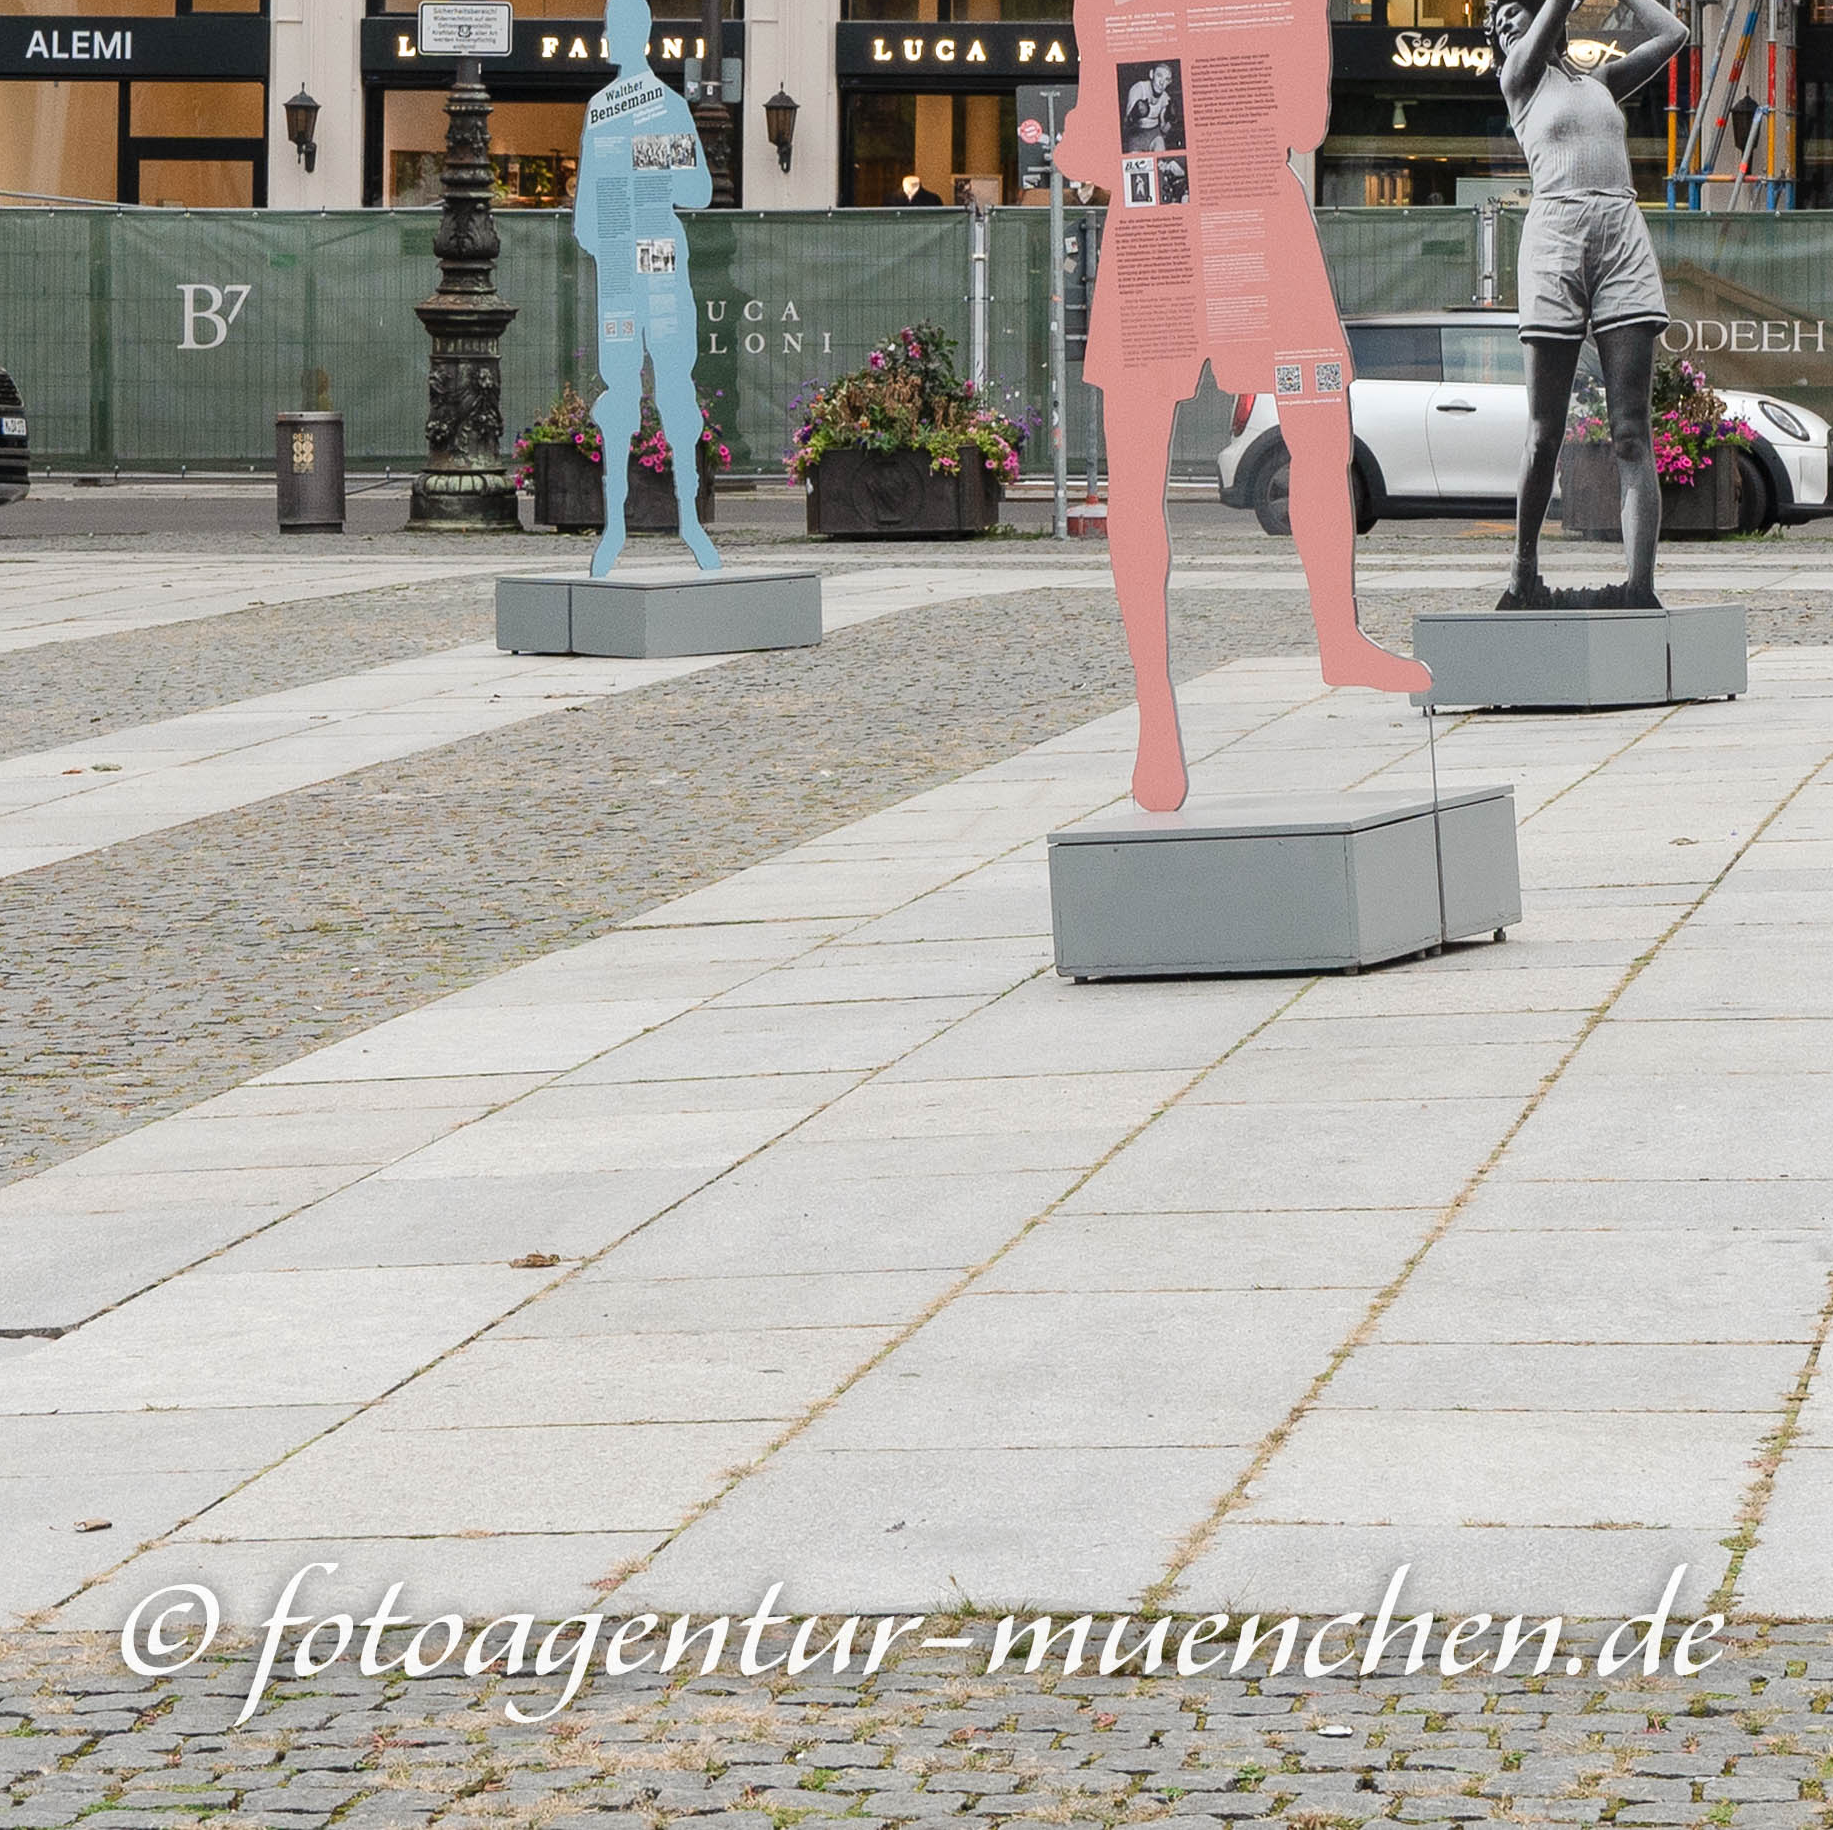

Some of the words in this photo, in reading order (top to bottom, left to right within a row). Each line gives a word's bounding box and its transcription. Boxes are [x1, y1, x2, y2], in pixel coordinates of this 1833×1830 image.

[25, 29, 133, 60] ALEMI
[872, 38, 987, 62] LUCA
[605, 80, 643, 102] Walther
[590, 86, 663, 124] Bensemann
[706, 299, 803, 322] UCA
[1659, 319, 1825, 353] ODEEH
